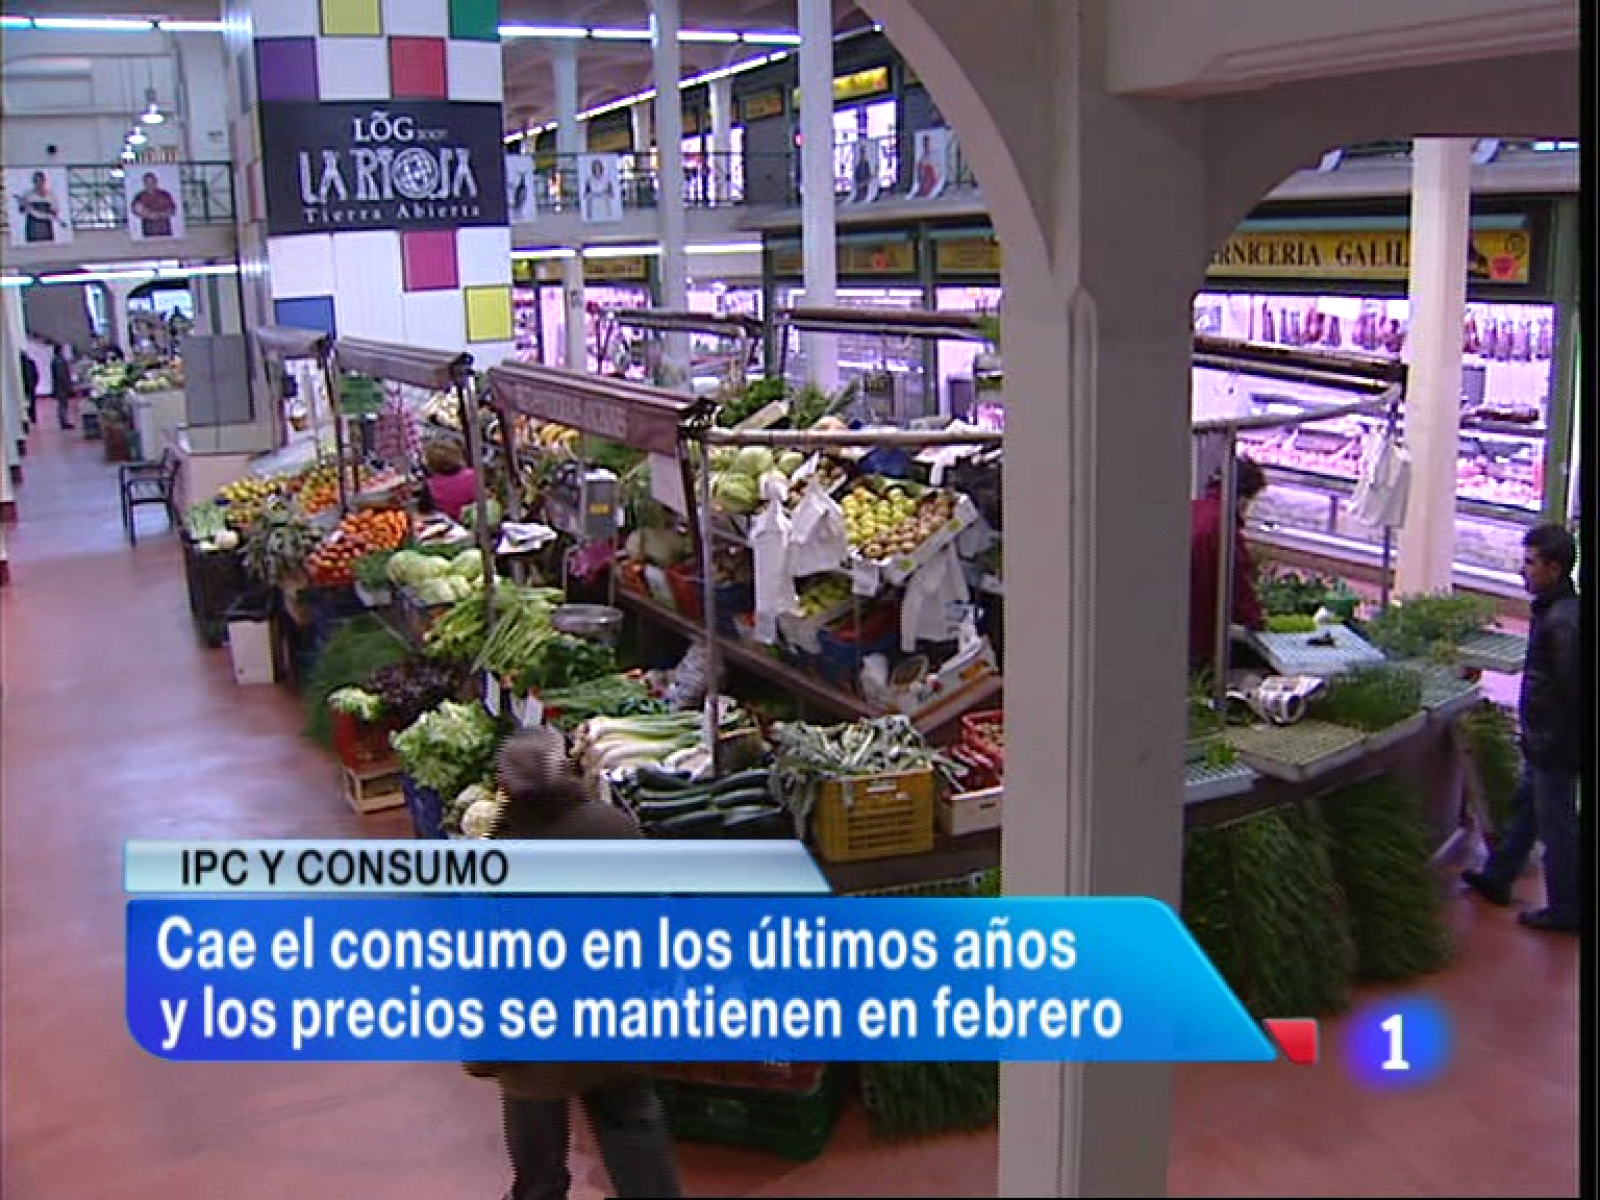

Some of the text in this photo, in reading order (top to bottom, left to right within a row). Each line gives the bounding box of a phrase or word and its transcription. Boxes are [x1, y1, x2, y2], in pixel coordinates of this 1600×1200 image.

[299, 147, 477, 204] LA RIOJA
[303, 203, 480, 223] Tierra Abierta
[1334, 240, 1411, 268] GALIL
